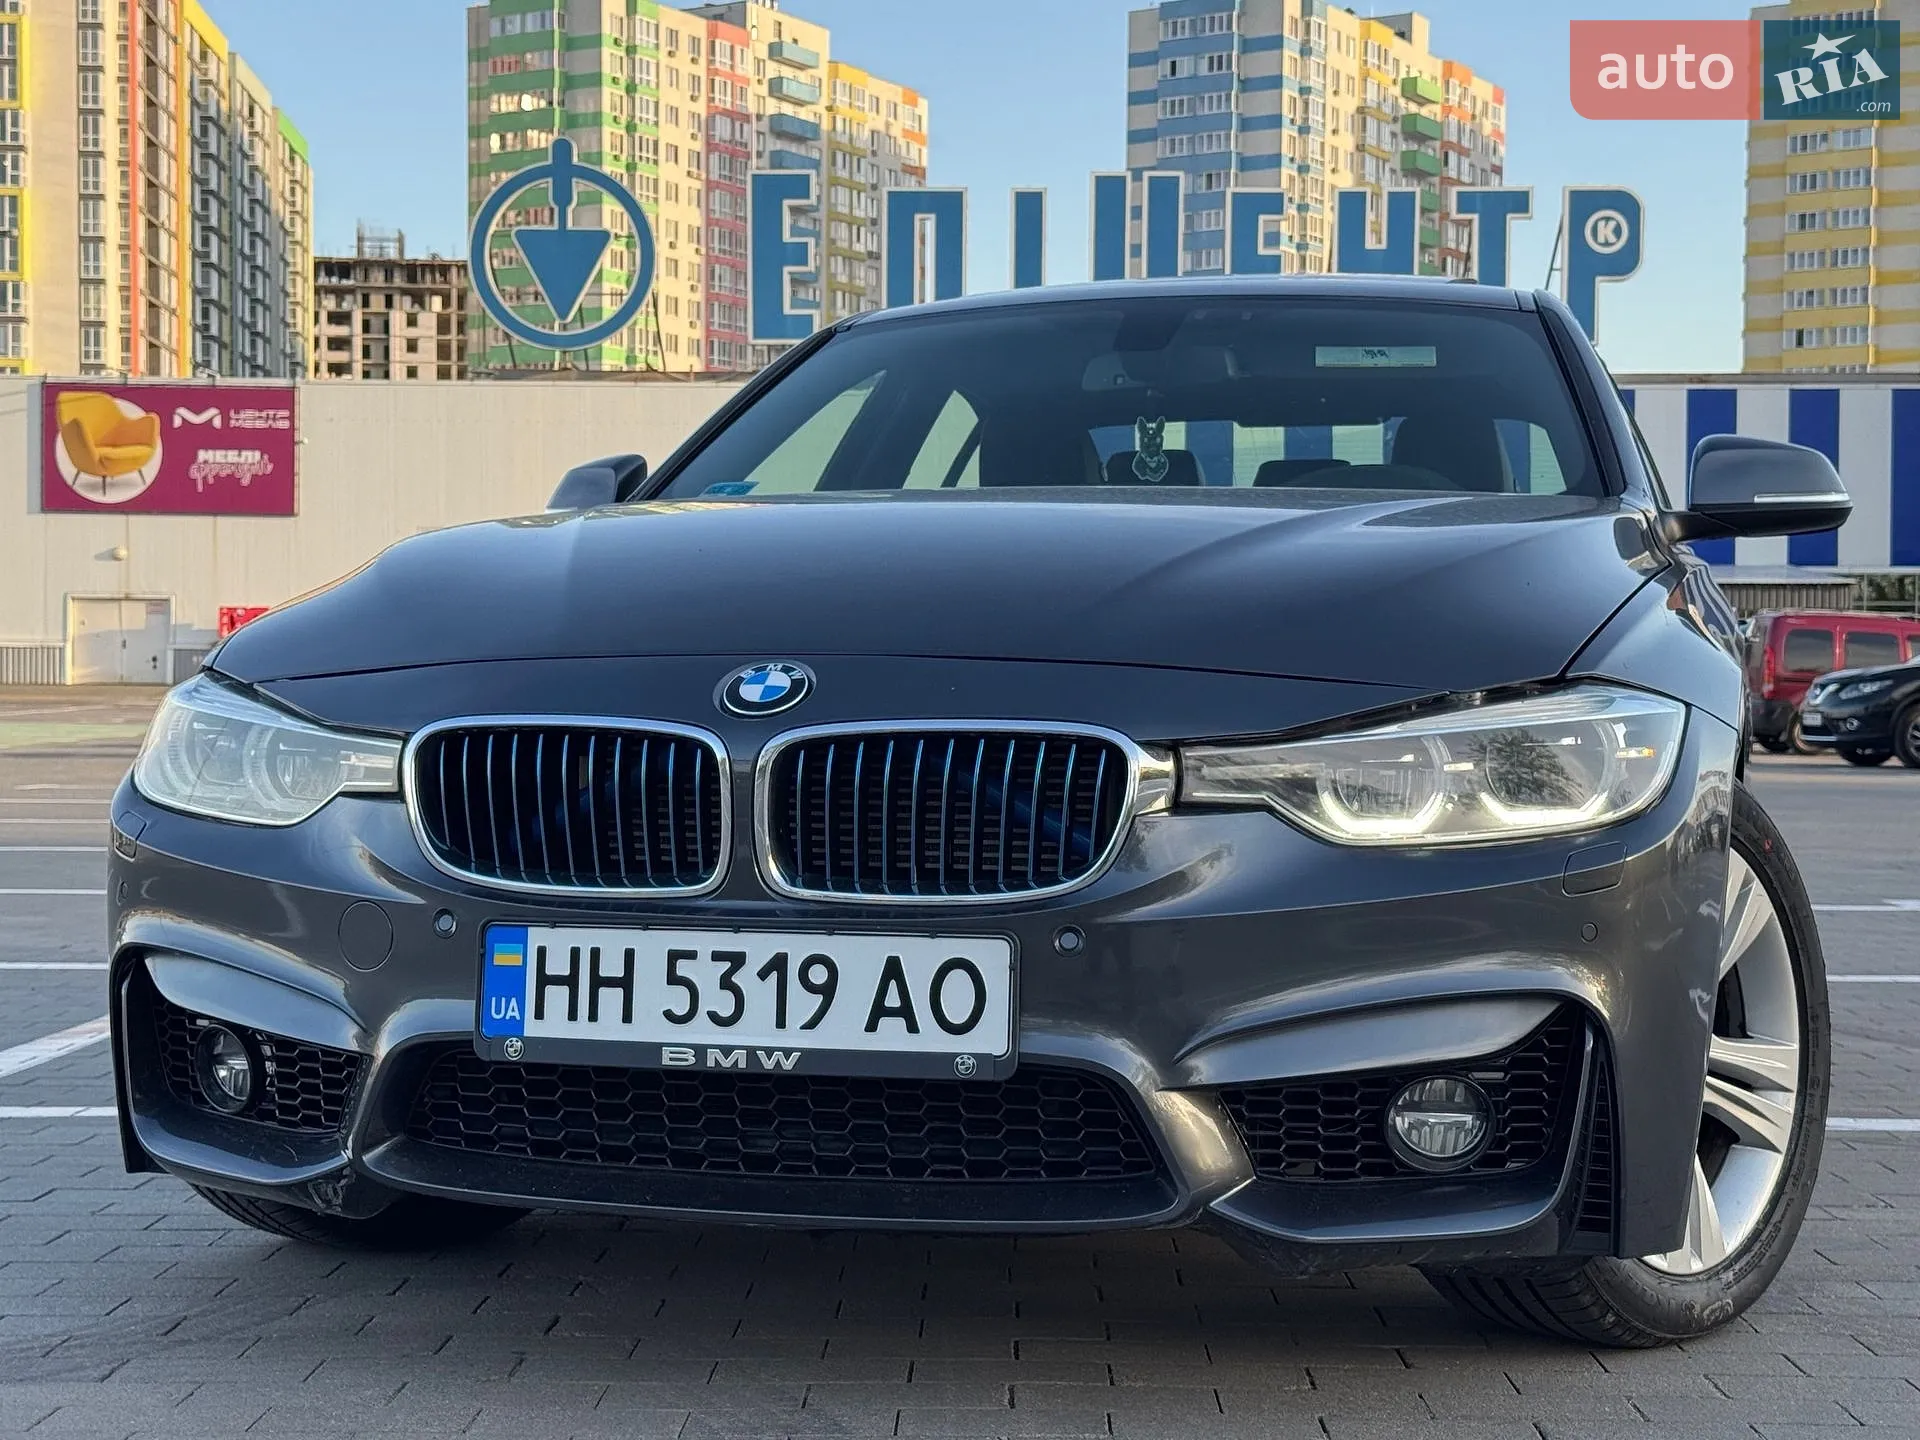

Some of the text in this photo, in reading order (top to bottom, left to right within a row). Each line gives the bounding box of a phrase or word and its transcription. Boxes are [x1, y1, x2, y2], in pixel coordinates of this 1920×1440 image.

[533, 944, 988, 1036] HH 5319 AO
[490, 997, 521, 1021] UA
[661, 1046, 802, 1071] BMW
